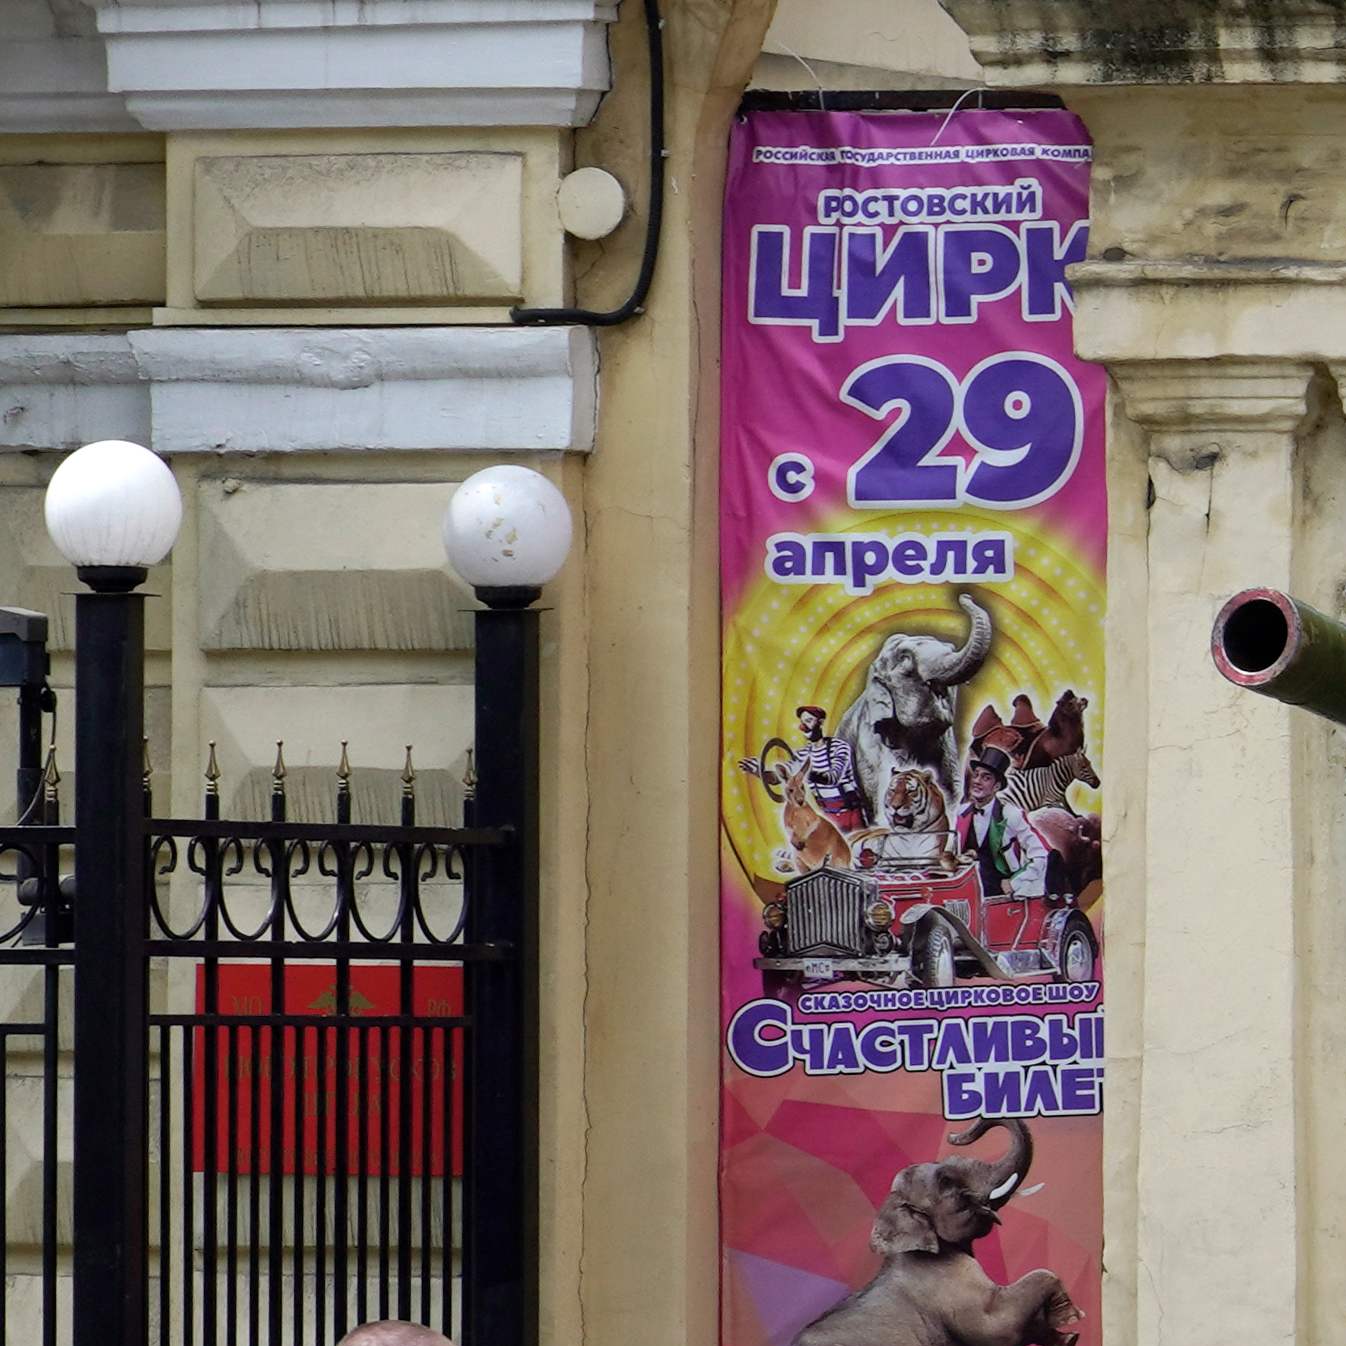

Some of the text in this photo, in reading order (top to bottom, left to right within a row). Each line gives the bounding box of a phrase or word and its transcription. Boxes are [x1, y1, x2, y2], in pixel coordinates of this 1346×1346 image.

[840, 149, 960, 164] ГОСУДАРСТВЕННАЯ
[965, 146, 1036, 160] ЦИРКОВАЯ
[1041, 147, 1093, 160] КОМПА
[823, 183, 1038, 220] РОСТОВСКИЙ
[752, 227, 1090, 338] ЦИРК
[845, 357, 1077, 503] 29
[772, 537, 1007, 589] апреля
[799, 983, 1099, 1011] СКАЗОЧНОЕ ЦИРКОВОЕ ШОУ
[732, 1002, 1104, 1074] СЧАСТЛИВЫ
[946, 1067, 1104, 1115] БИЛЕ
